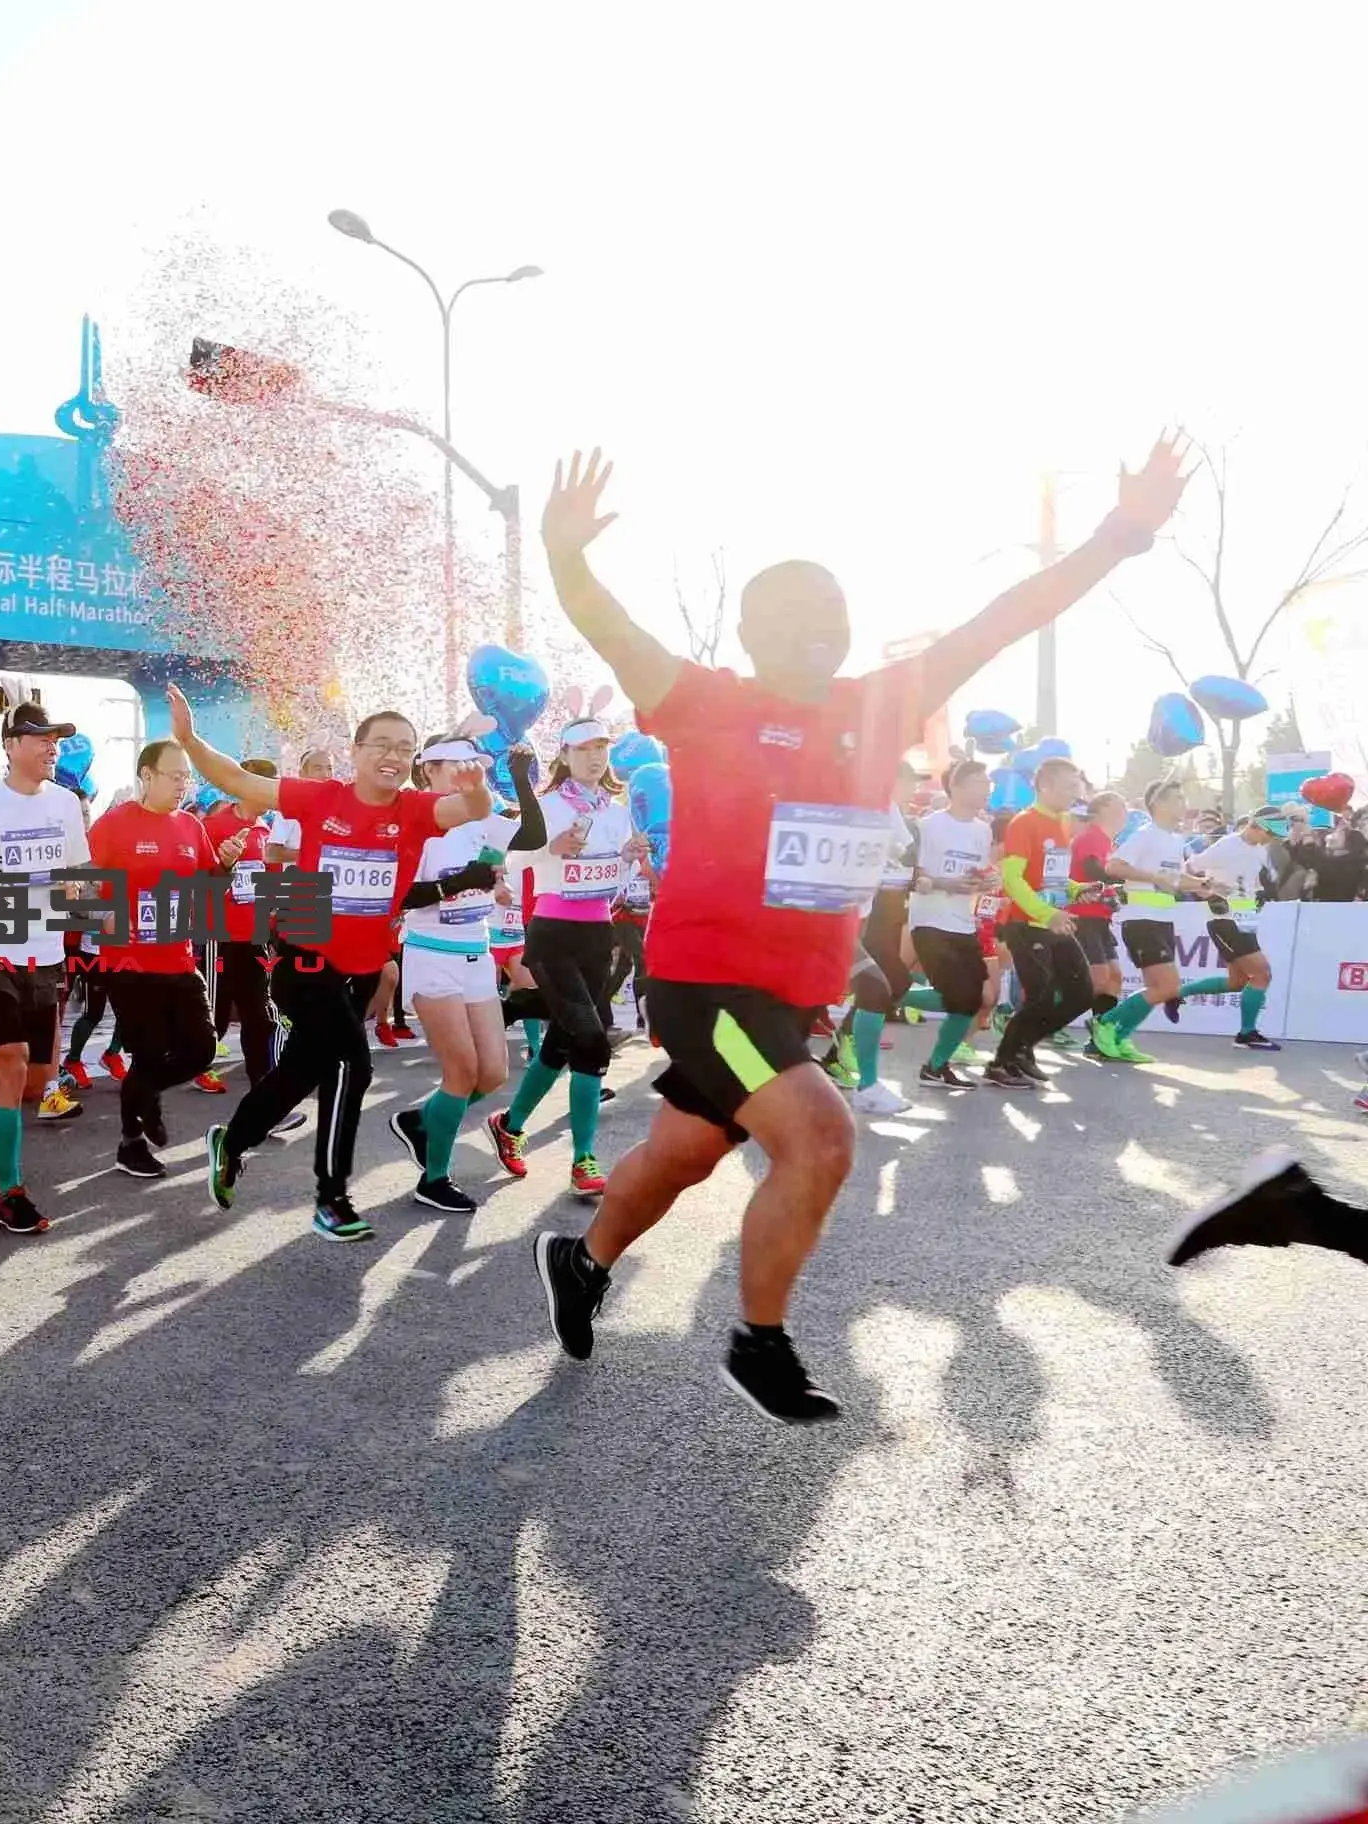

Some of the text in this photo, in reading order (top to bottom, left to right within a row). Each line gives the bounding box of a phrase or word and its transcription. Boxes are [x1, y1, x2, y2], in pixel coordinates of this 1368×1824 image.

[25, 595, 64, 617] Half
[25, 844, 63, 862] 1196
[344, 868, 392, 887] 0186
